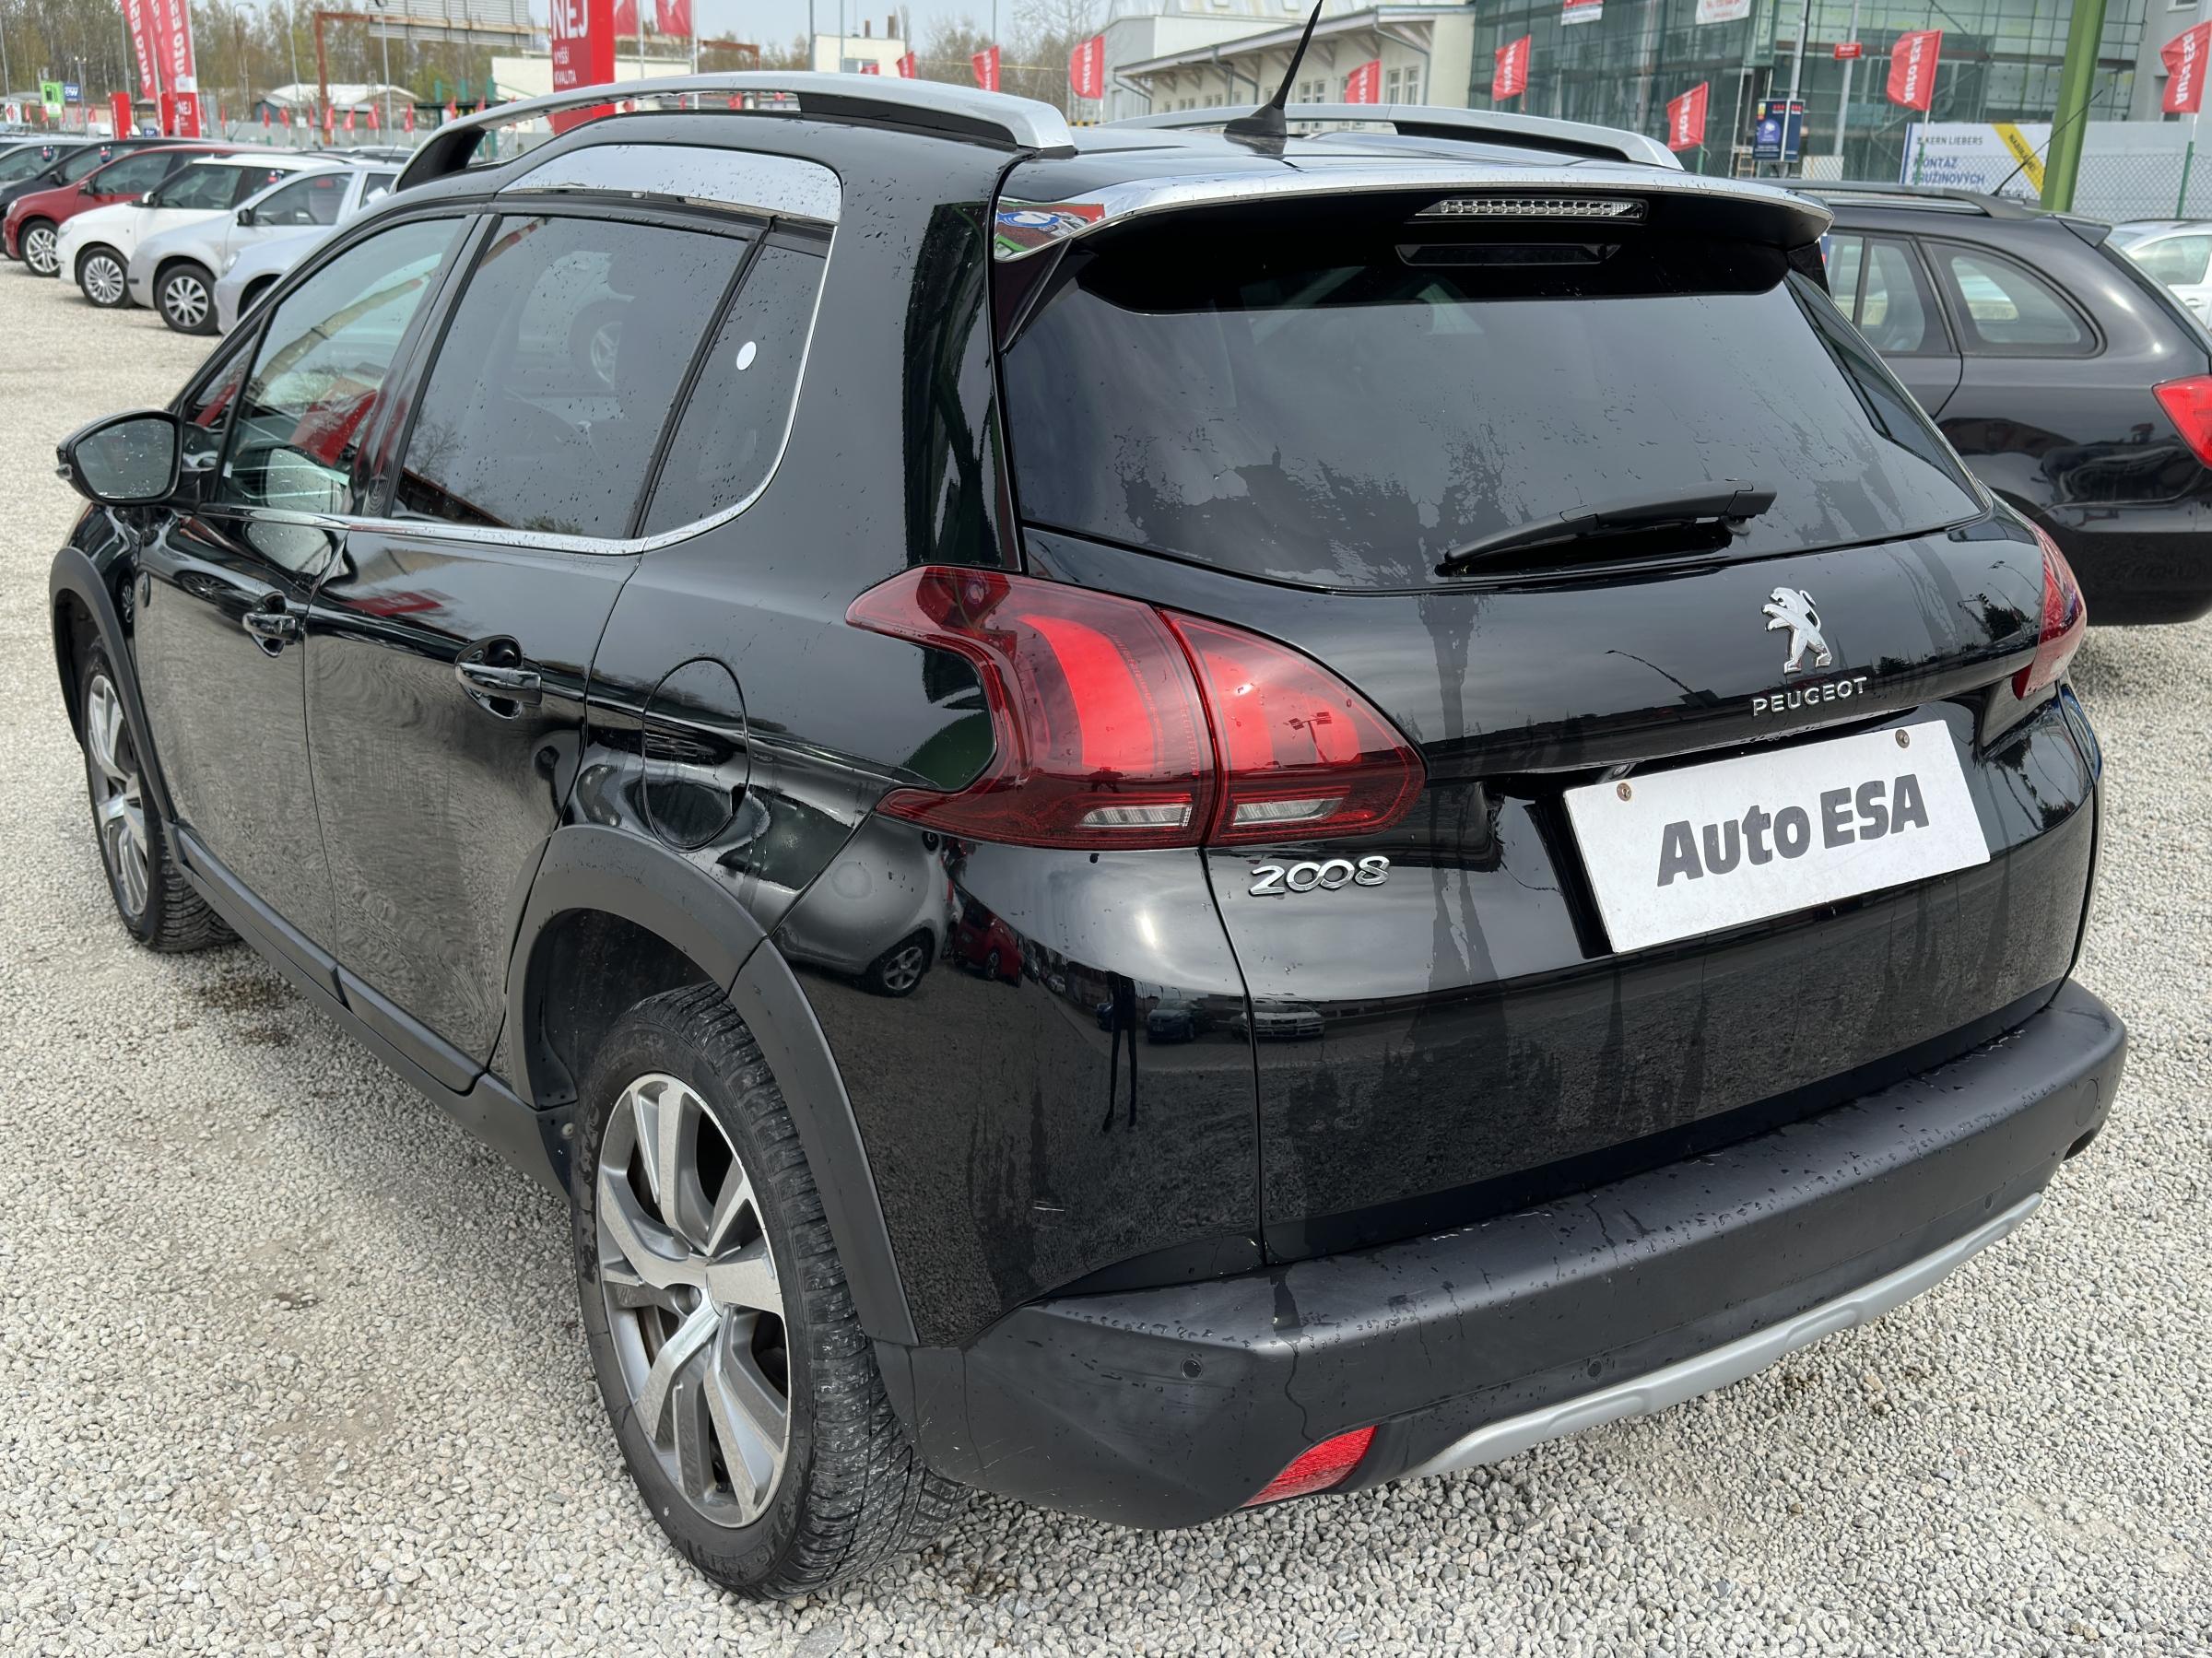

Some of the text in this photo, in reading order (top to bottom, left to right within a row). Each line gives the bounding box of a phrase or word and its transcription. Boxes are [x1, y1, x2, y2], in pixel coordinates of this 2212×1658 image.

[553, 0, 588, 40] NEJ
[1949, 136, 1983, 146] LIEBERS
[1752, 676, 1867, 717] PEUGEOT
[1656, 773, 1930, 888] Auto ESA
[1249, 855, 1390, 895] 2008
